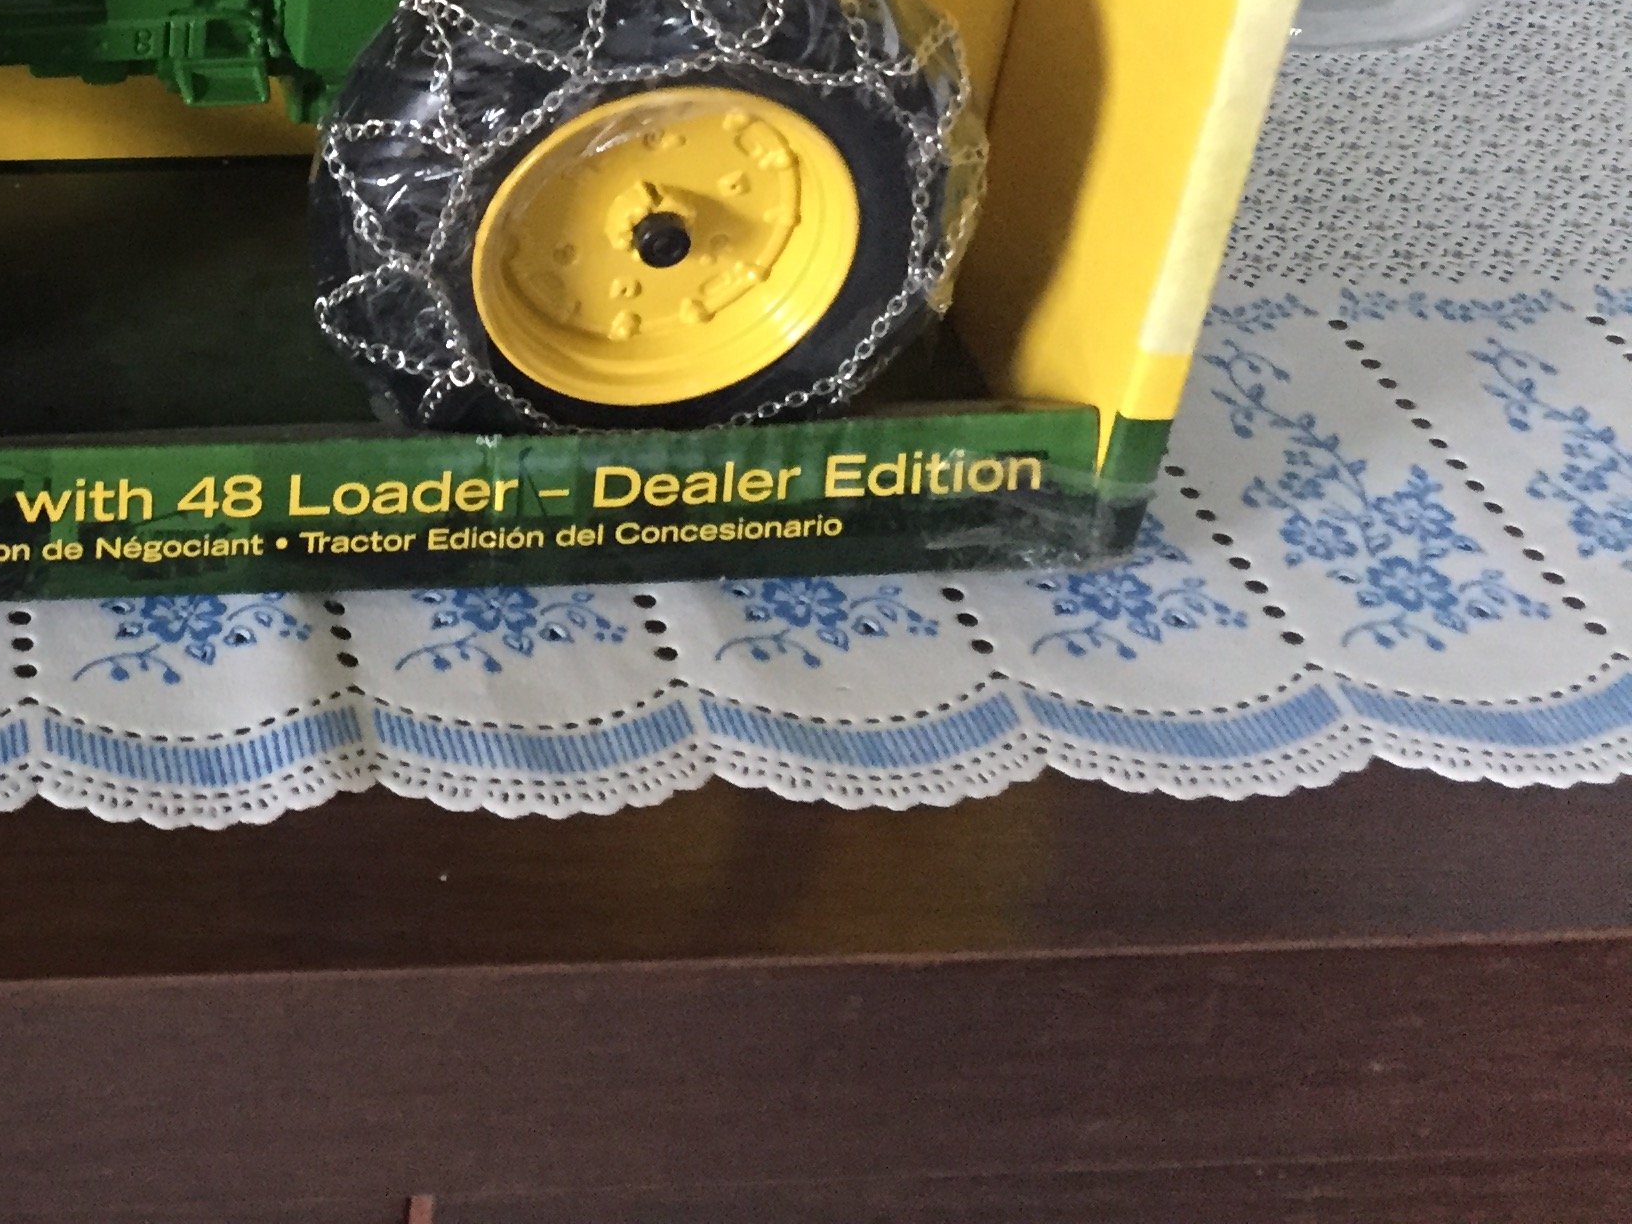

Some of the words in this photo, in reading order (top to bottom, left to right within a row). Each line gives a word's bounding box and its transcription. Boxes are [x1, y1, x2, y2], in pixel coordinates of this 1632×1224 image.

[15, 476, 154, 527] with
[176, 474, 264, 518] 48
[288, 469, 519, 518] Loader
[592, 455, 802, 510] Dealer
[824, 449, 1044, 500] Edition
[41, 536, 85, 563] de
[94, 530, 264, 566] Négociant
[300, 527, 417, 555] Tractor
[426, 522, 545, 552] Edición
[557, 520, 604, 548] del
[614, 513, 844, 546] Concesionario
